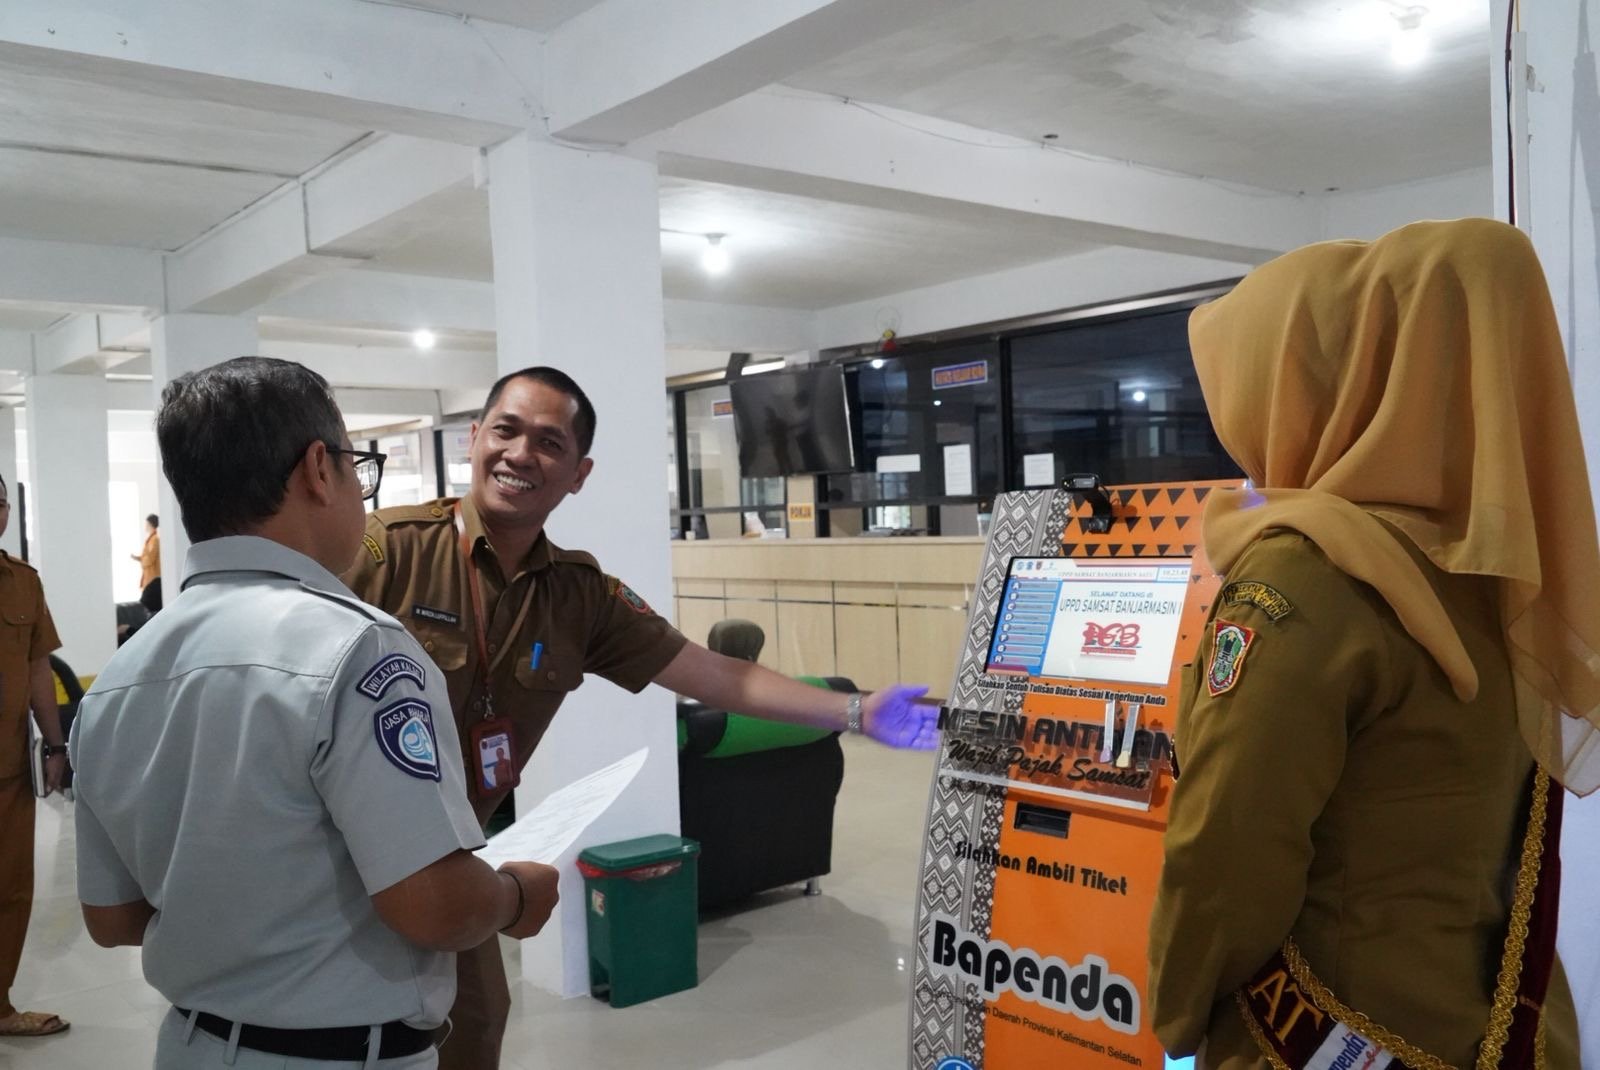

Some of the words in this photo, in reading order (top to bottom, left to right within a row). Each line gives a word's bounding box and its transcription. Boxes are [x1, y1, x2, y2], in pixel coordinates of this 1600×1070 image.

[1059, 599, 1081, 612] UPPD
[1081, 599, 1115, 613] SAMSAT
[1115, 600, 1177, 615] BANJARMASIN
[367, 661, 401, 691] WILAYAH
[1005, 681, 1028, 691] Sentuh
[1030, 684, 1055, 694] Tulisan
[1055, 686, 1078, 696] Diatas
[1079, 688, 1104, 699] Sesuai
[1104, 691, 1145, 703] Keperluan
[1145, 695, 1166, 706] Anda
[384, 710, 408, 730] JASA
[937, 706, 1028, 740] MESIN
[948, 740, 1003, 769] Wajib
[1003, 747, 1065, 777] Pajak
[1067, 758, 1150, 789] Samsat
[955, 841, 1021, 871] Silahkan
[1026, 856, 1075, 883] Ambil
[1081, 868, 1127, 896] Tiket
[933, 919, 1133, 1026] Bapenda
[992, 1007, 1021, 1024] Daerah
[1023, 1017, 1056, 1037] Provinsi
[1057, 1029, 1105, 1054] Kalimantan
[1107, 1046, 1142, 1067] Selatan
